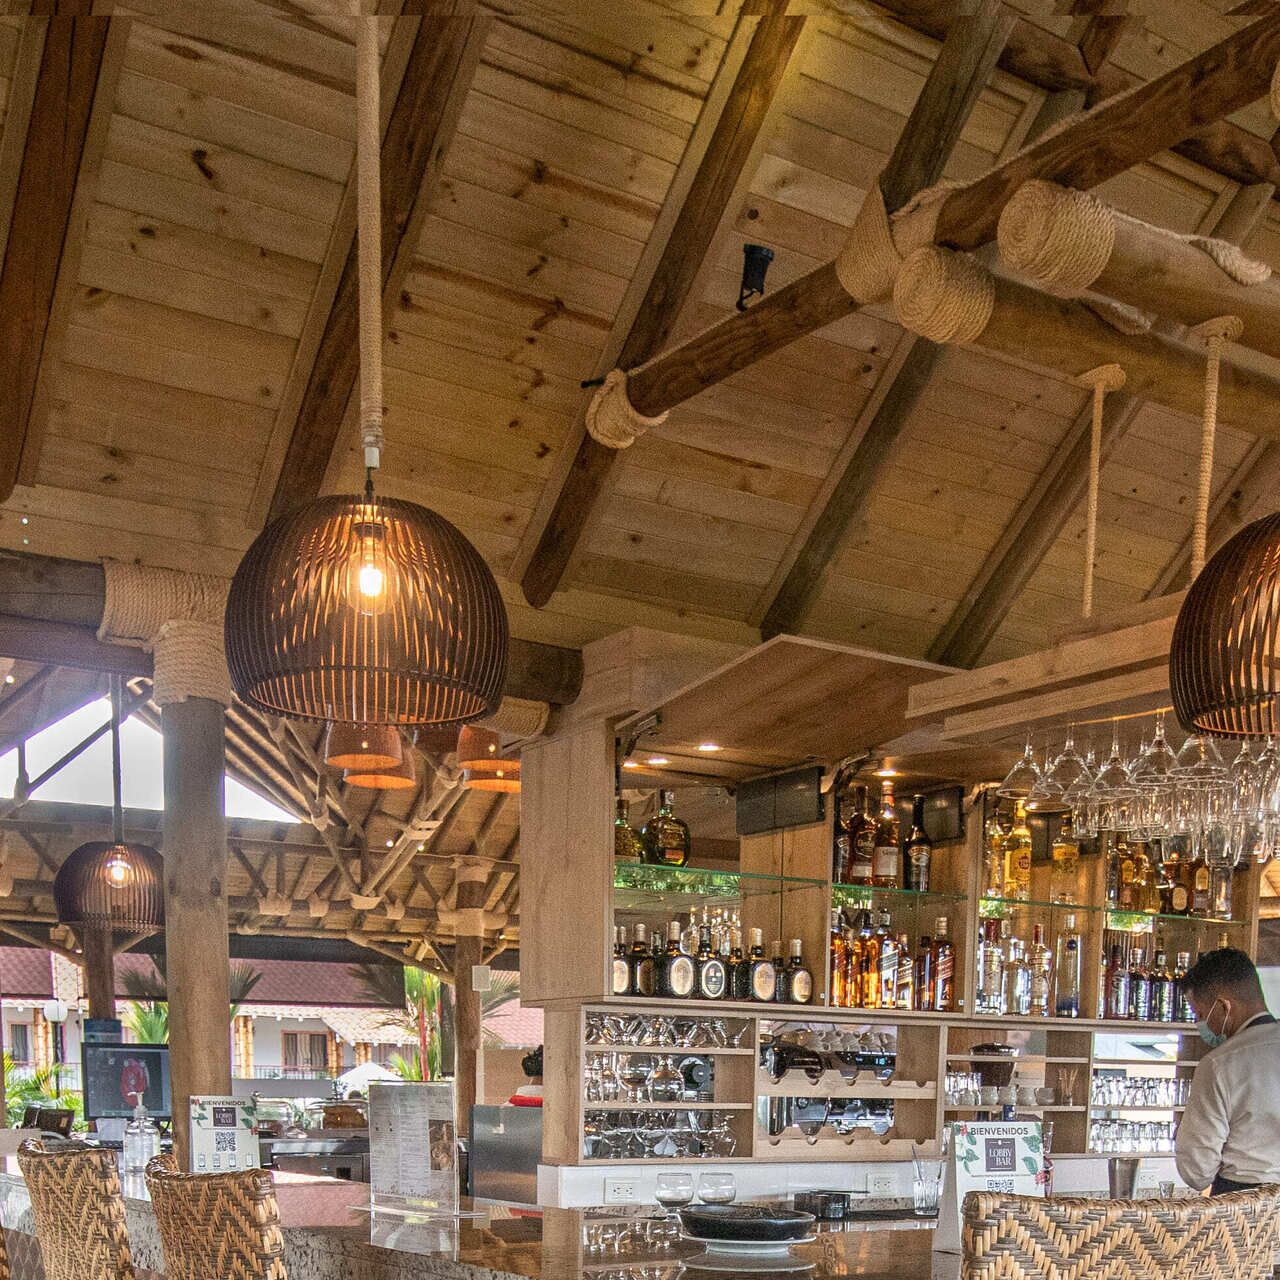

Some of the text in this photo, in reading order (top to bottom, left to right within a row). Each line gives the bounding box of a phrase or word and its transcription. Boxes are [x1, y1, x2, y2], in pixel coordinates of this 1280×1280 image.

[970, 1127, 1029, 1136] BIENVENIDOS
[989, 1148, 1013, 1157] LOBBY
[995, 1157, 1012, 1165] BAR
